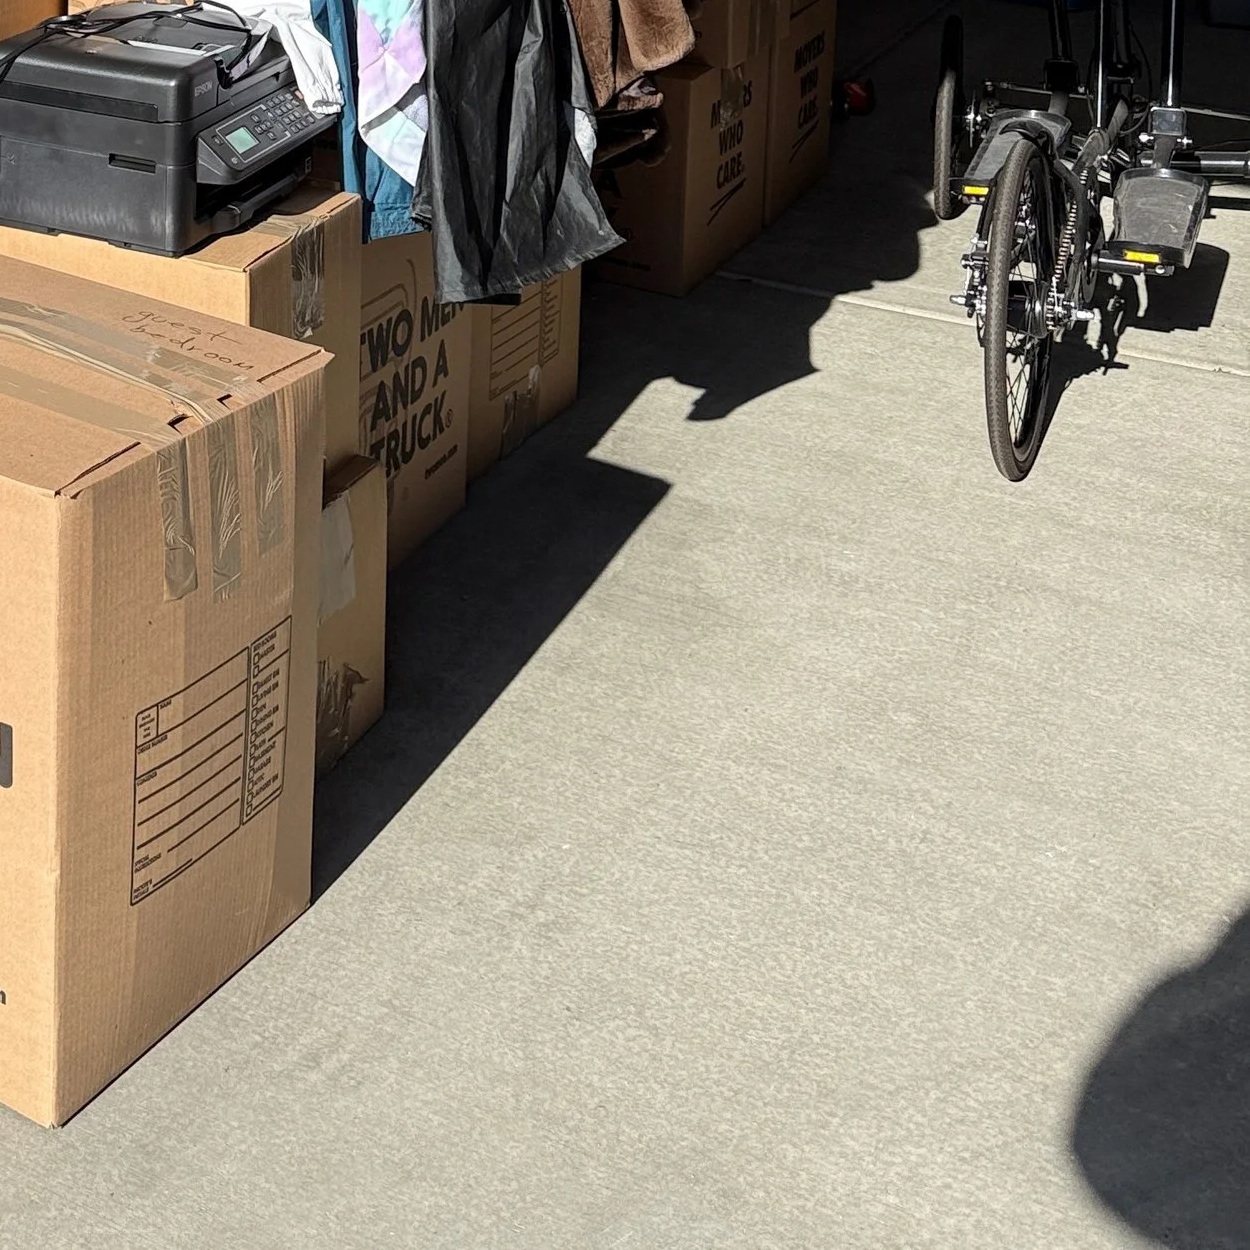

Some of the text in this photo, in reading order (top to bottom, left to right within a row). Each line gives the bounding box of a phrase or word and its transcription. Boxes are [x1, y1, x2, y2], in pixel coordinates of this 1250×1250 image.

[719, 119, 743, 155] WHO
[122, 311, 242, 345] guest
[129, 324, 254, 370] bedroom
[370, 339, 449, 432] AND A
